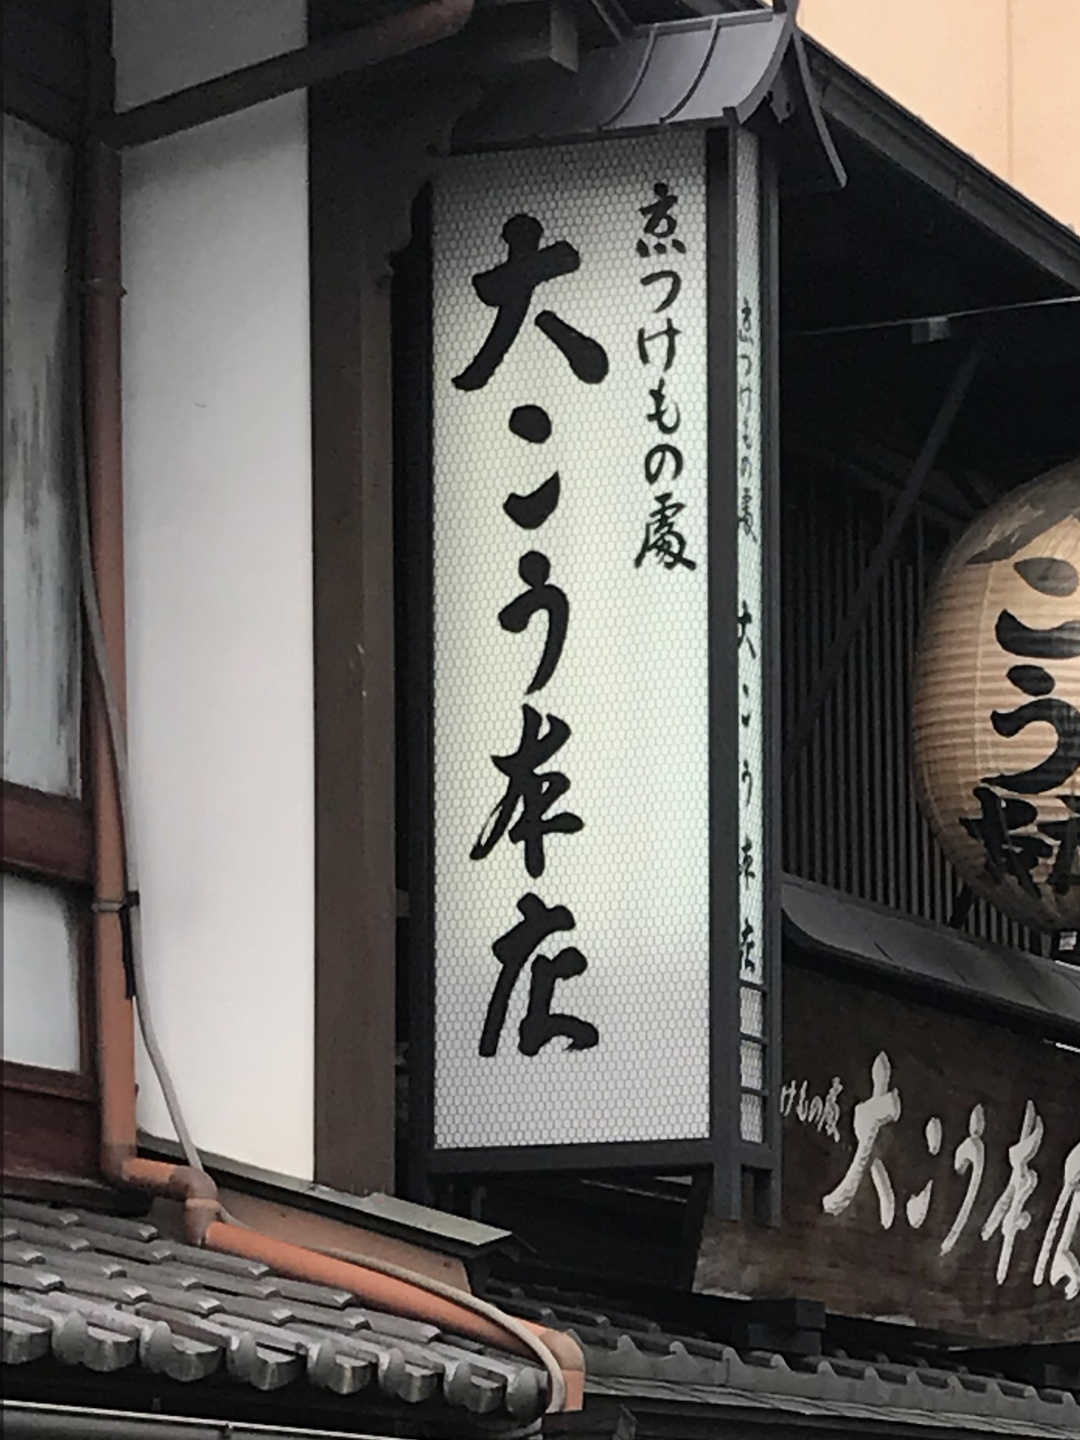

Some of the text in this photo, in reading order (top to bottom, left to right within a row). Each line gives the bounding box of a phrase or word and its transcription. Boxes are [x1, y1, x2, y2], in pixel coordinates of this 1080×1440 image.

[451, 213, 608, 1057] 大こう本店
